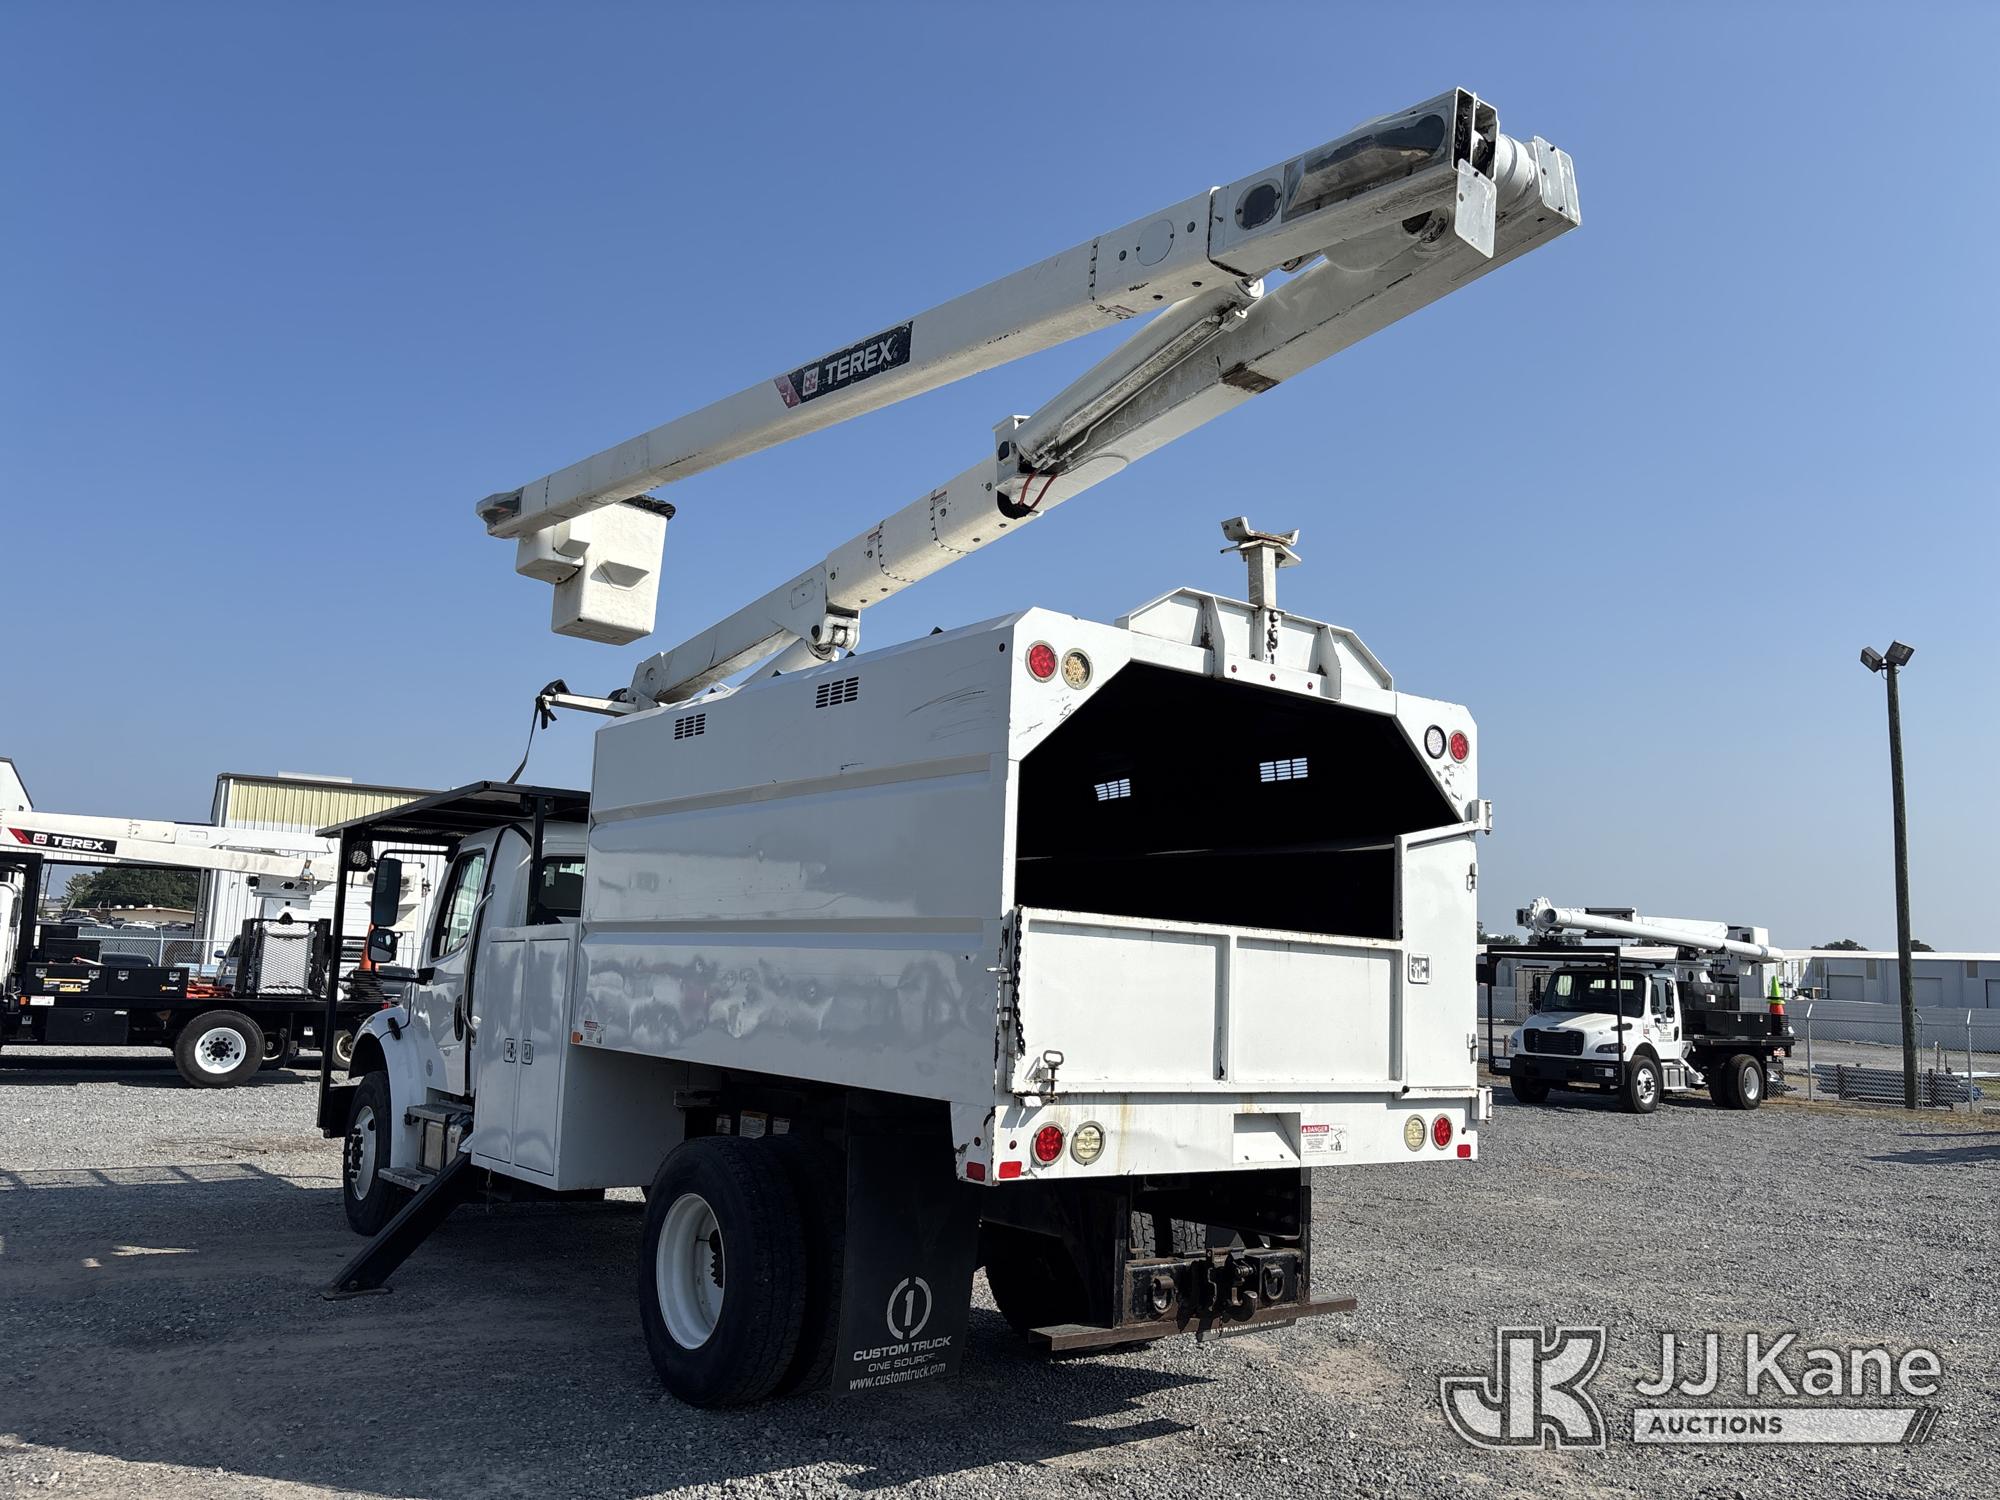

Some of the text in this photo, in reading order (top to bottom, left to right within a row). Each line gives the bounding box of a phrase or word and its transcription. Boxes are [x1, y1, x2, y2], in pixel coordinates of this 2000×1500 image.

[826, 336, 895, 384] TEREX
[53, 836, 105, 851] TEREX
[853, 1335, 952, 1362] CUSTOM TRUCK
[849, 1362, 946, 1391] www.customtruck.com
[868, 1361, 891, 1373] ONE
